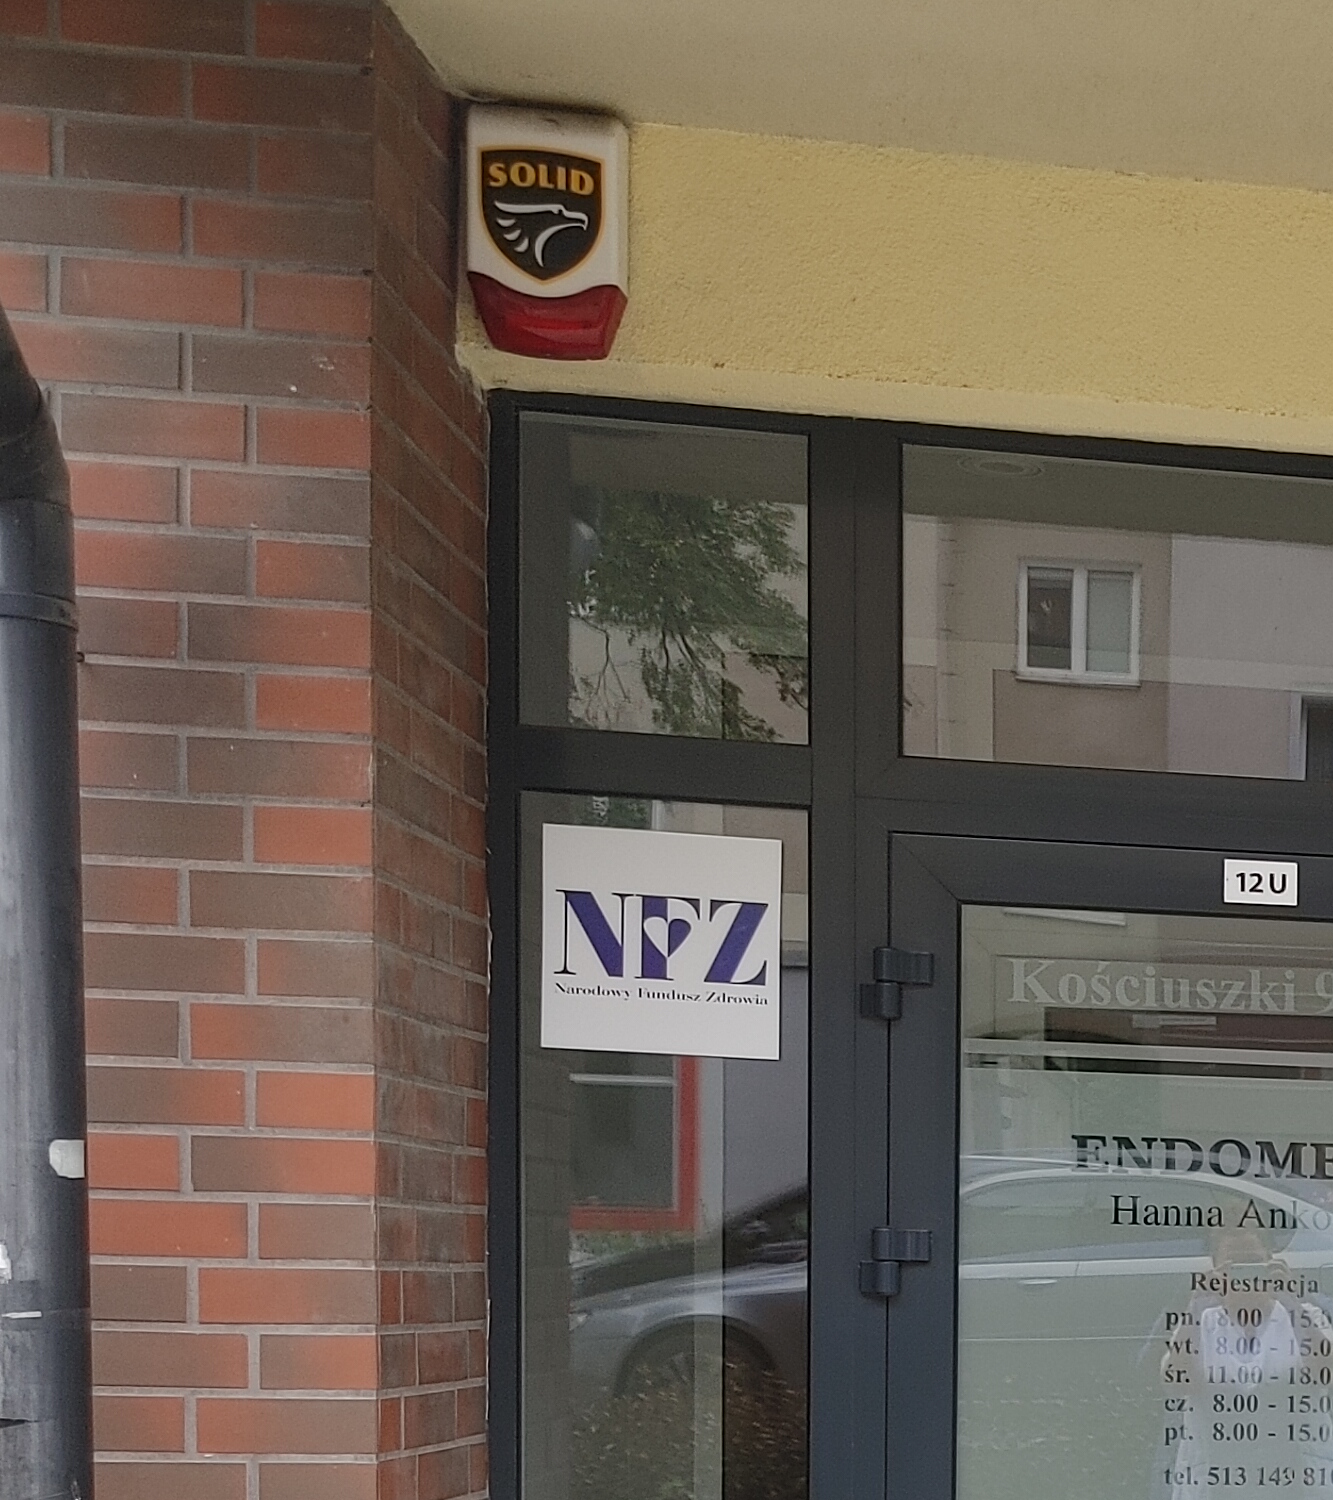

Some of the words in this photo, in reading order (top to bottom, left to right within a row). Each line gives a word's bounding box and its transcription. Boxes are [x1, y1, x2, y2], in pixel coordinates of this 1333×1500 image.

[488, 162, 594, 195] SOLID
[1236, 872, 1264, 893] 12
[1270, 873, 1287, 894] U
[554, 889, 769, 986] NFZ
[554, 982, 632, 1001] Narodowy
[638, 986, 702, 1002] Fundusz
[705, 990, 768, 1006] Zdrowia
[1007, 957, 1297, 1013] Kościuszki
[1110, 1195, 1225, 1228] Hanna
[1190, 1272, 1319, 1298] Rejestracja
[1165, 1311, 1201, 1331] pn.
[1165, 1338, 1199, 1355] wt.
[1215, 1336, 1262, 1355] 8.00
[1164, 1364, 1191, 1383] śr.
[1206, 1366, 1263, 1384] 11.00
[1164, 1397, 1194, 1412] cz.
[1213, 1394, 1259, 1413] 8.00
[1164, 1426, 1194, 1446] pt.
[1212, 1422, 1258, 1442] 8.00
[1164, 1467, 1199, 1486] tel.
[1207, 1467, 1247, 1486] 513
[1257, 1467, 1295, 1486] 149
